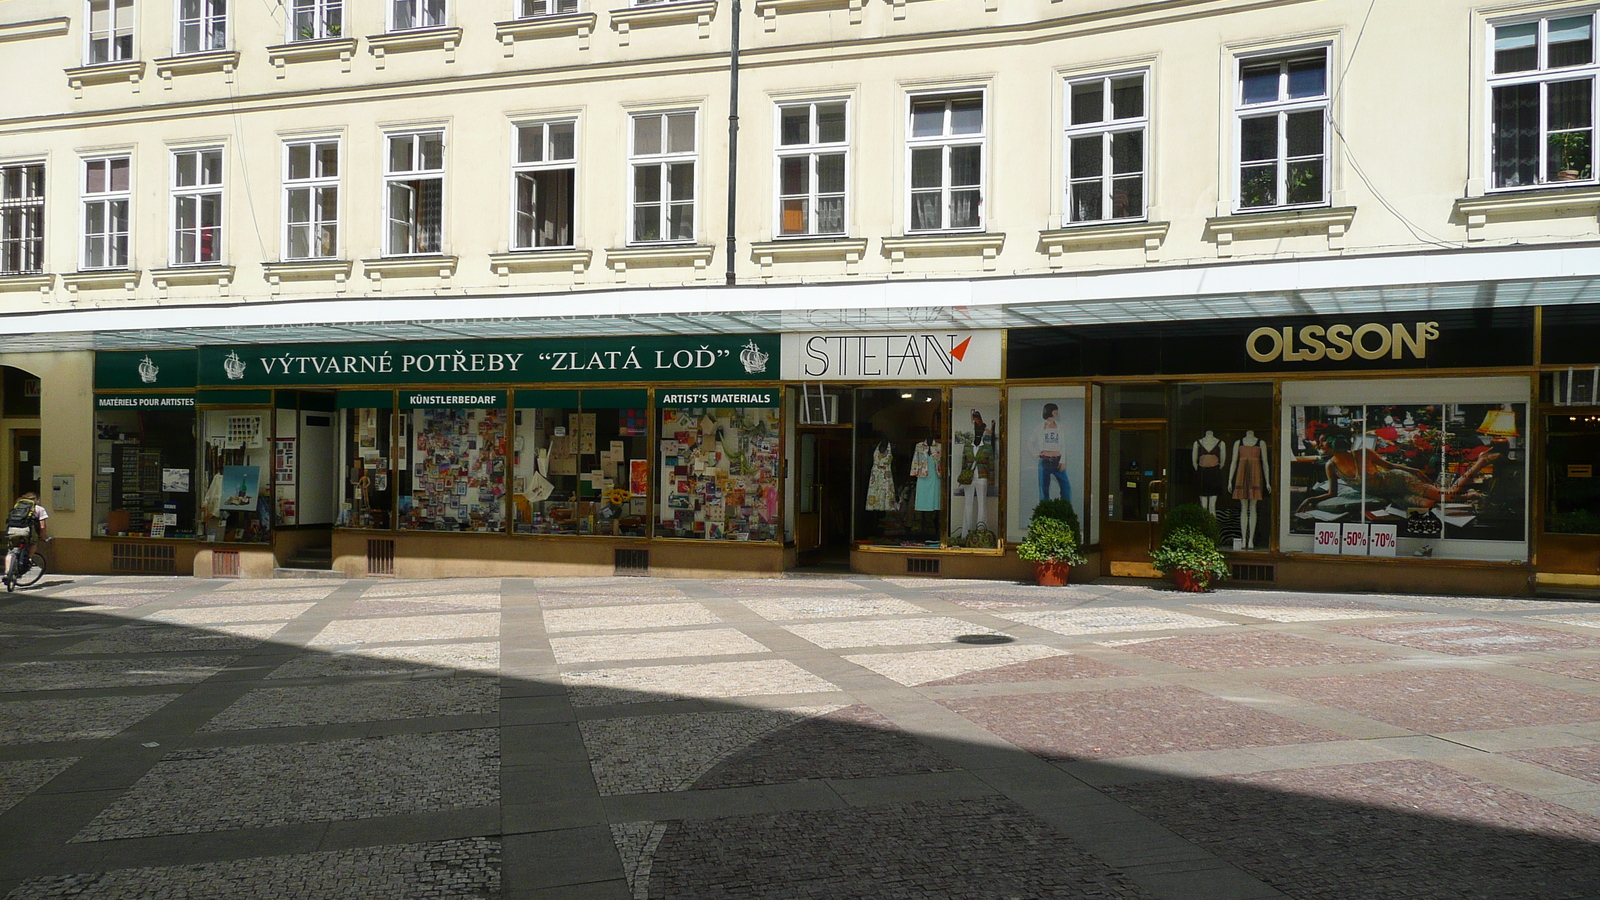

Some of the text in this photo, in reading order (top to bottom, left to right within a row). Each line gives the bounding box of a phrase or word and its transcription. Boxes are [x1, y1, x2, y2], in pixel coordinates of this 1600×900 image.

[260, 345, 730, 374] VÝTVARNÉ POTŘEBY “ZLATÁ LOĎ”
[805, 334, 958, 376] STEFAN
[99, 397, 195, 406] MATÉRIELS POUR ARTISTES
[410, 394, 497, 404] KÜNSTLERBEDARF
[711, 394, 771, 403] MATERIALS
[1315, 531, 1339, 545] -30%
[1343, 532, 1367, 546] -50%
[1371, 533, 1395, 547] -70%
